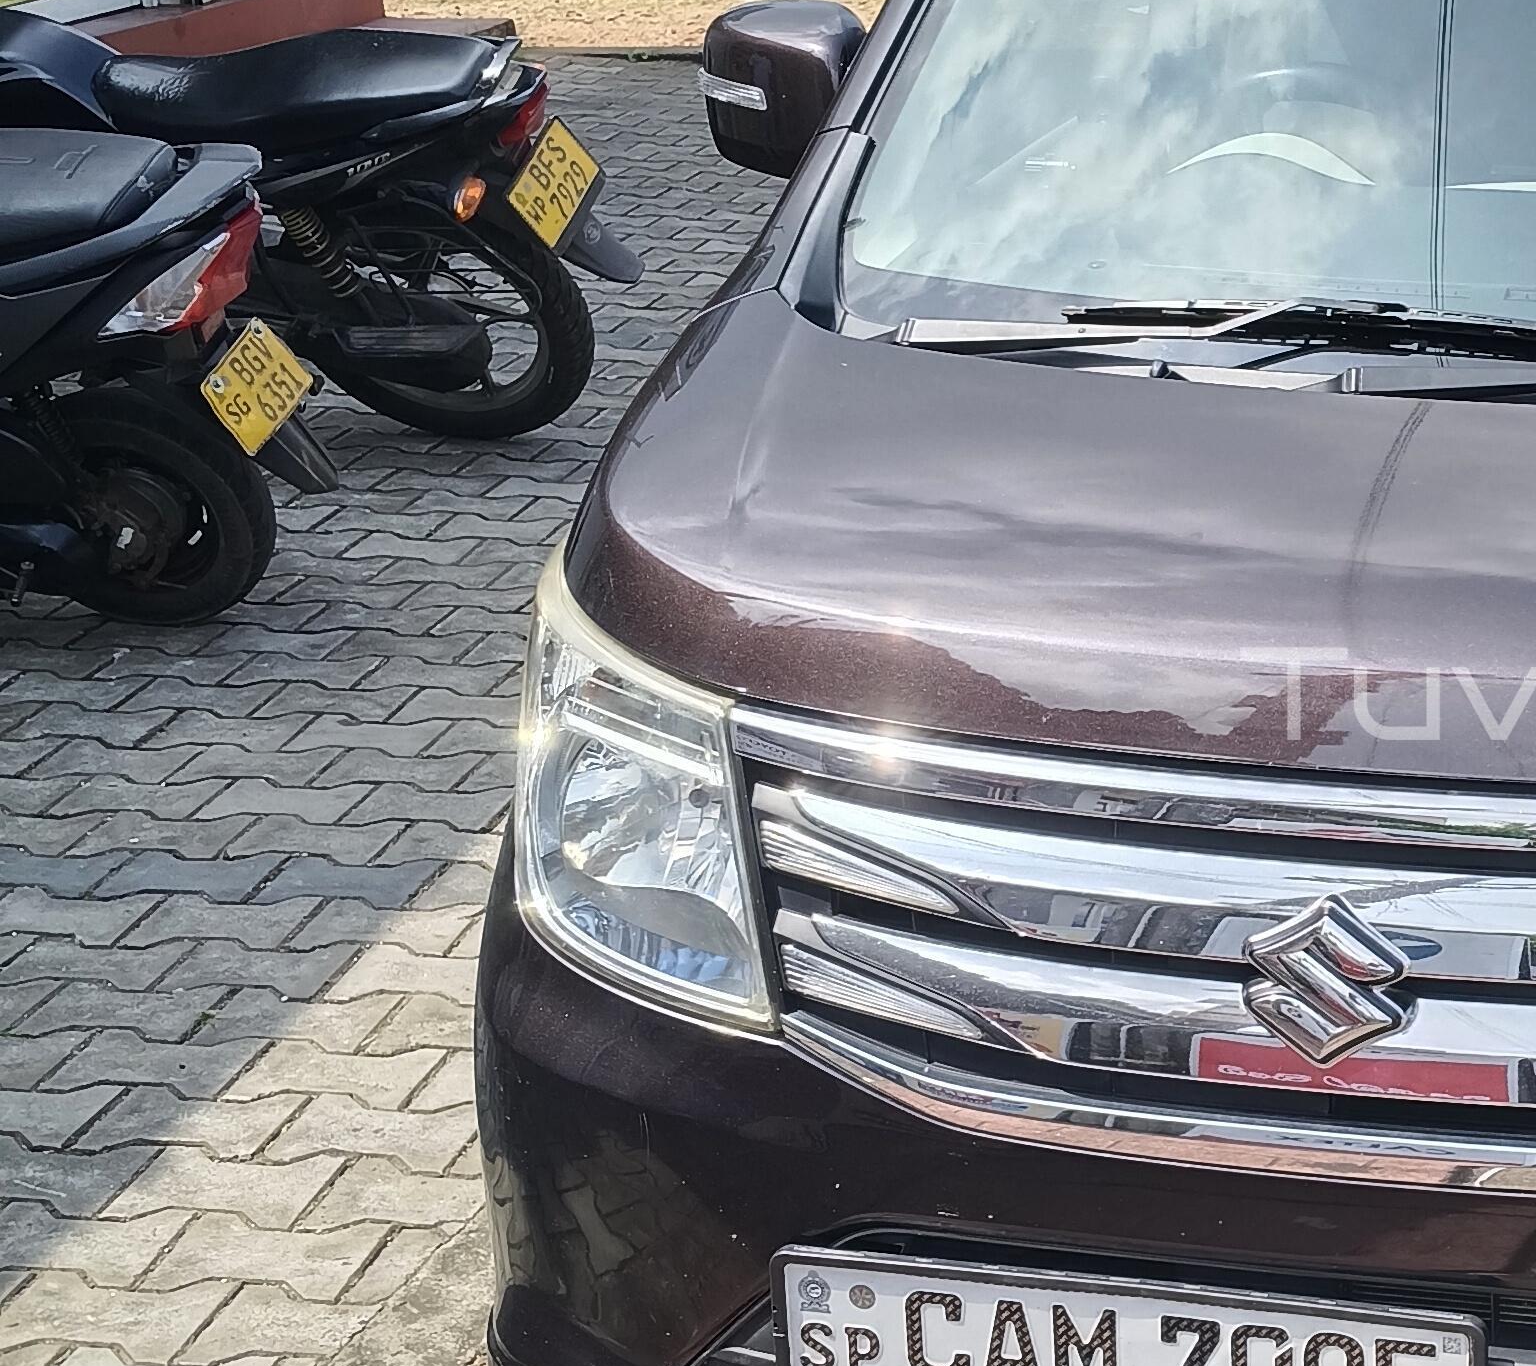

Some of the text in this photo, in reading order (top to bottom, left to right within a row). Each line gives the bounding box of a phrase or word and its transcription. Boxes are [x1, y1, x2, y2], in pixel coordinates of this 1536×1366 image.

[528, 136, 567, 192] BFS
[526, 196, 548, 226] WP
[228, 335, 274, 387] BGV
[225, 362, 304, 425] SG 6351
